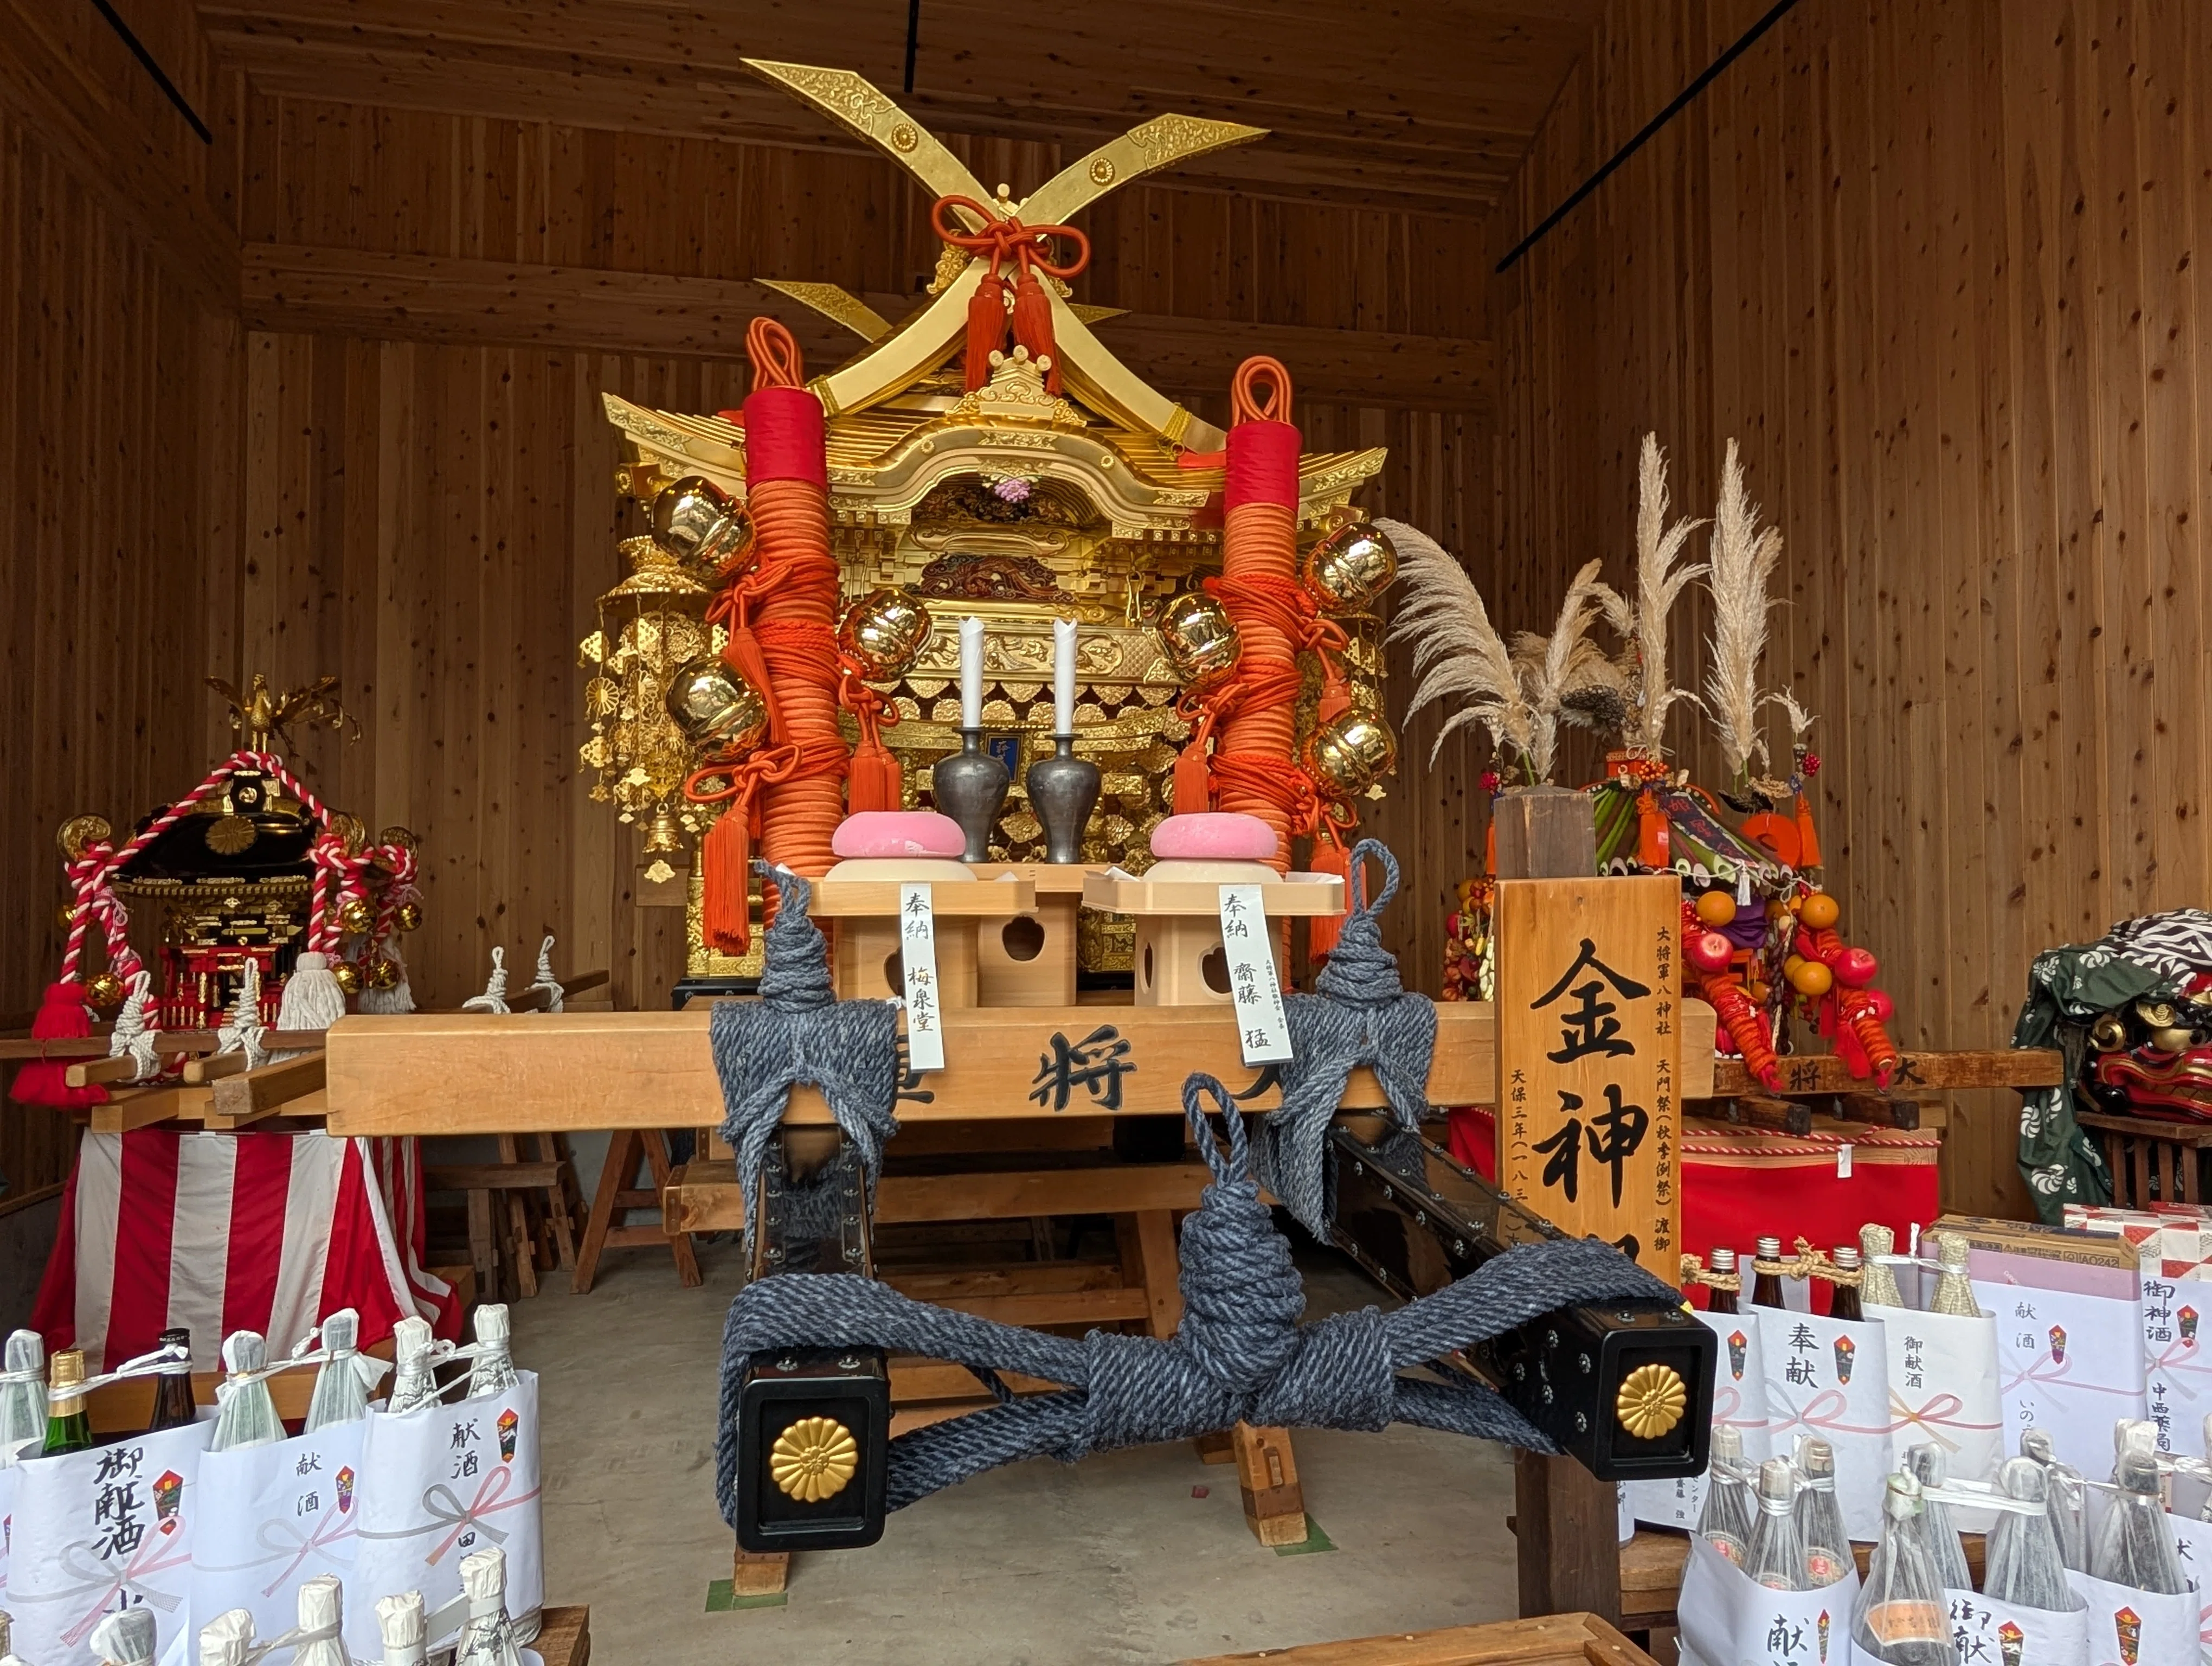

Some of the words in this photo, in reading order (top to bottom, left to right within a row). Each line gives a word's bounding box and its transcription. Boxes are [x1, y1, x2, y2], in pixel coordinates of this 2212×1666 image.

[904, 892, 930, 940] 奉納
[908, 966, 935, 1033] 梅泉堂
[1224, 893, 1248, 939] 奉納
[1245, 1028, 1272, 1049] 猛
[1529, 937, 1651, 1264] 金神
[2014, 1301, 2037, 1350] 献酒
[2143, 1280, 2176, 1343] 御神酒
[1785, 1322, 1820, 1389] 奉献
[1904, 1335, 1924, 1389] 御献酒
[449, 1418, 481, 1479] 献酒
[295, 1451, 323, 1517] 献酒
[1767, 1613, 1810, 1666] 献
